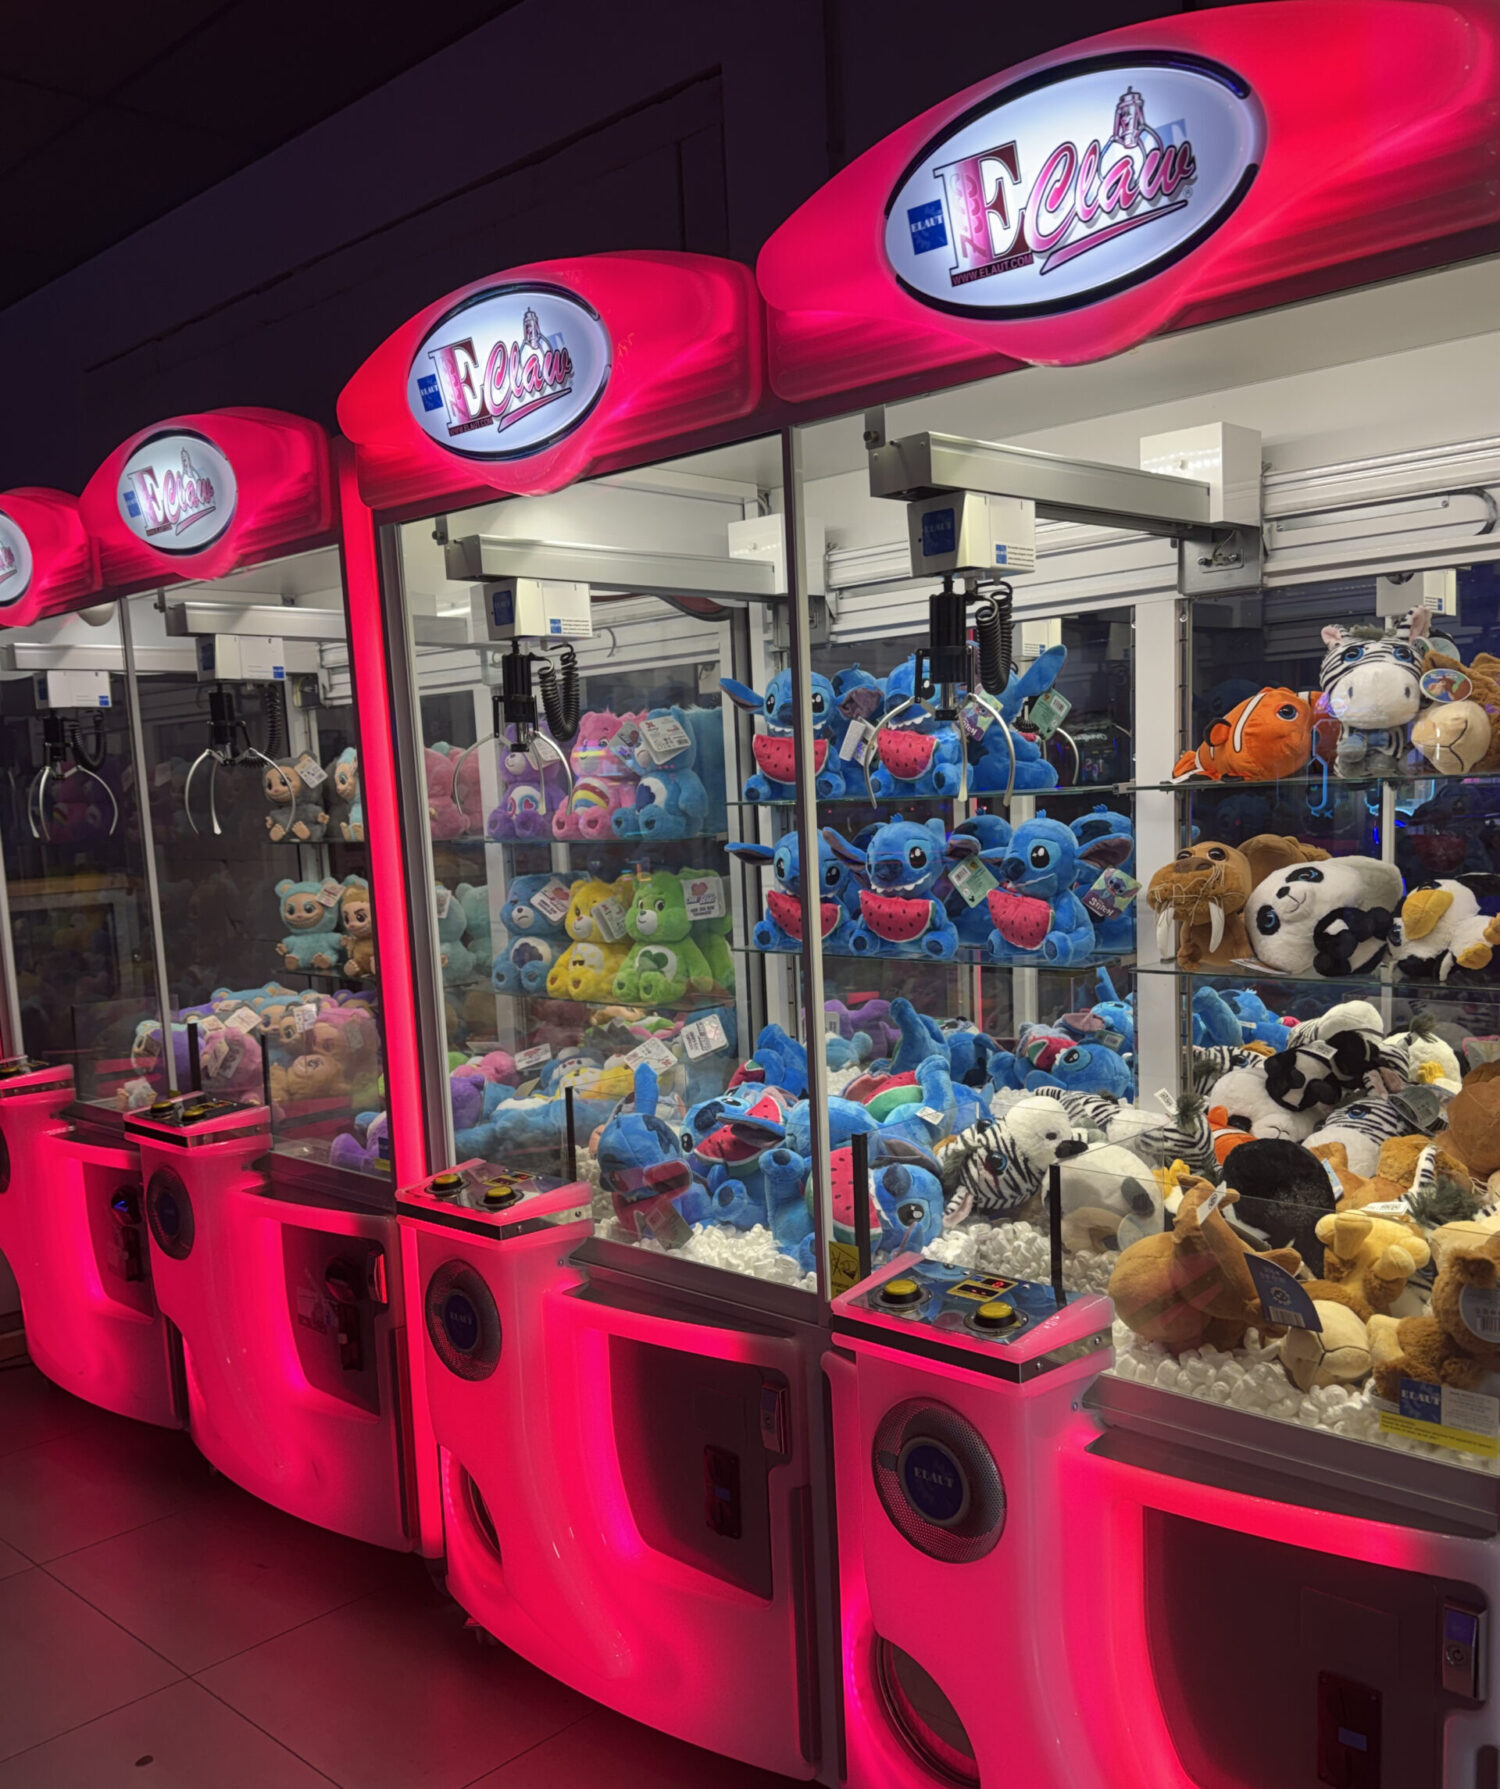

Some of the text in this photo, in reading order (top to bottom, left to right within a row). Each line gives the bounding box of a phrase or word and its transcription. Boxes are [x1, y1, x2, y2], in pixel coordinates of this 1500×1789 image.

[911, 213, 945, 233] ELAUT
[952, 253, 1033, 286] WWW.ELAUT.COM
[1401, 1389, 1440, 1405] ELAUT
[914, 1466, 954, 1488] ELAUT
